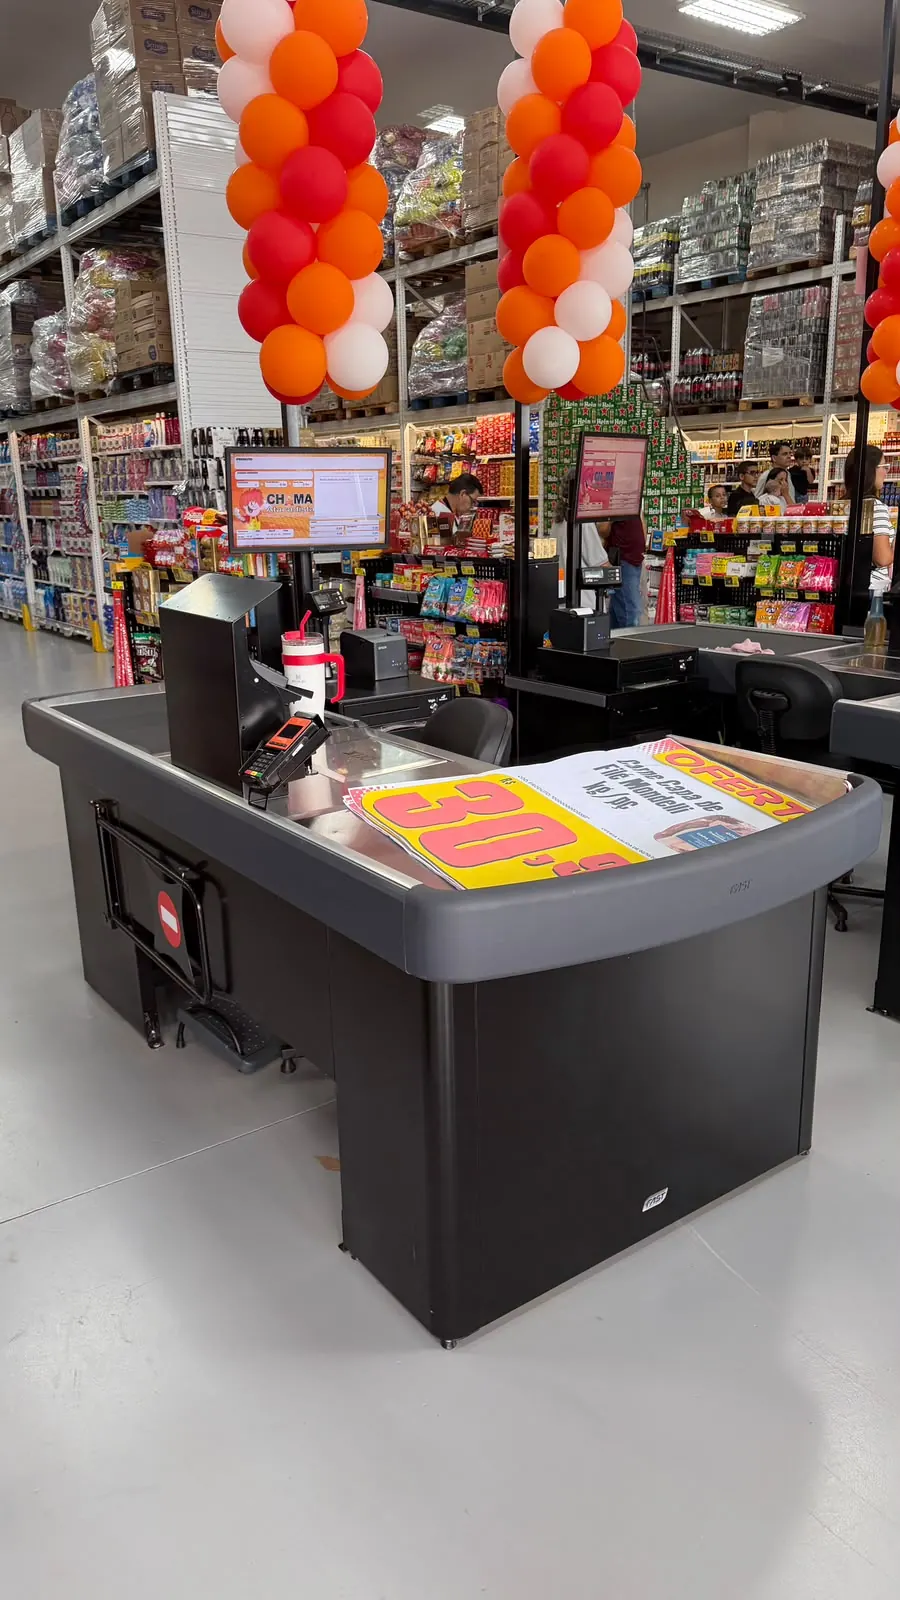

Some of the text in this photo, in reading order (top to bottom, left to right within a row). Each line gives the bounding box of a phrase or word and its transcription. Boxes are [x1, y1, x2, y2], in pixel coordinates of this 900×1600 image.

[593, 763, 631, 781] Filé
[619, 777, 693, 815] Mondelli
[616, 758, 724, 813] Carne Capa de
